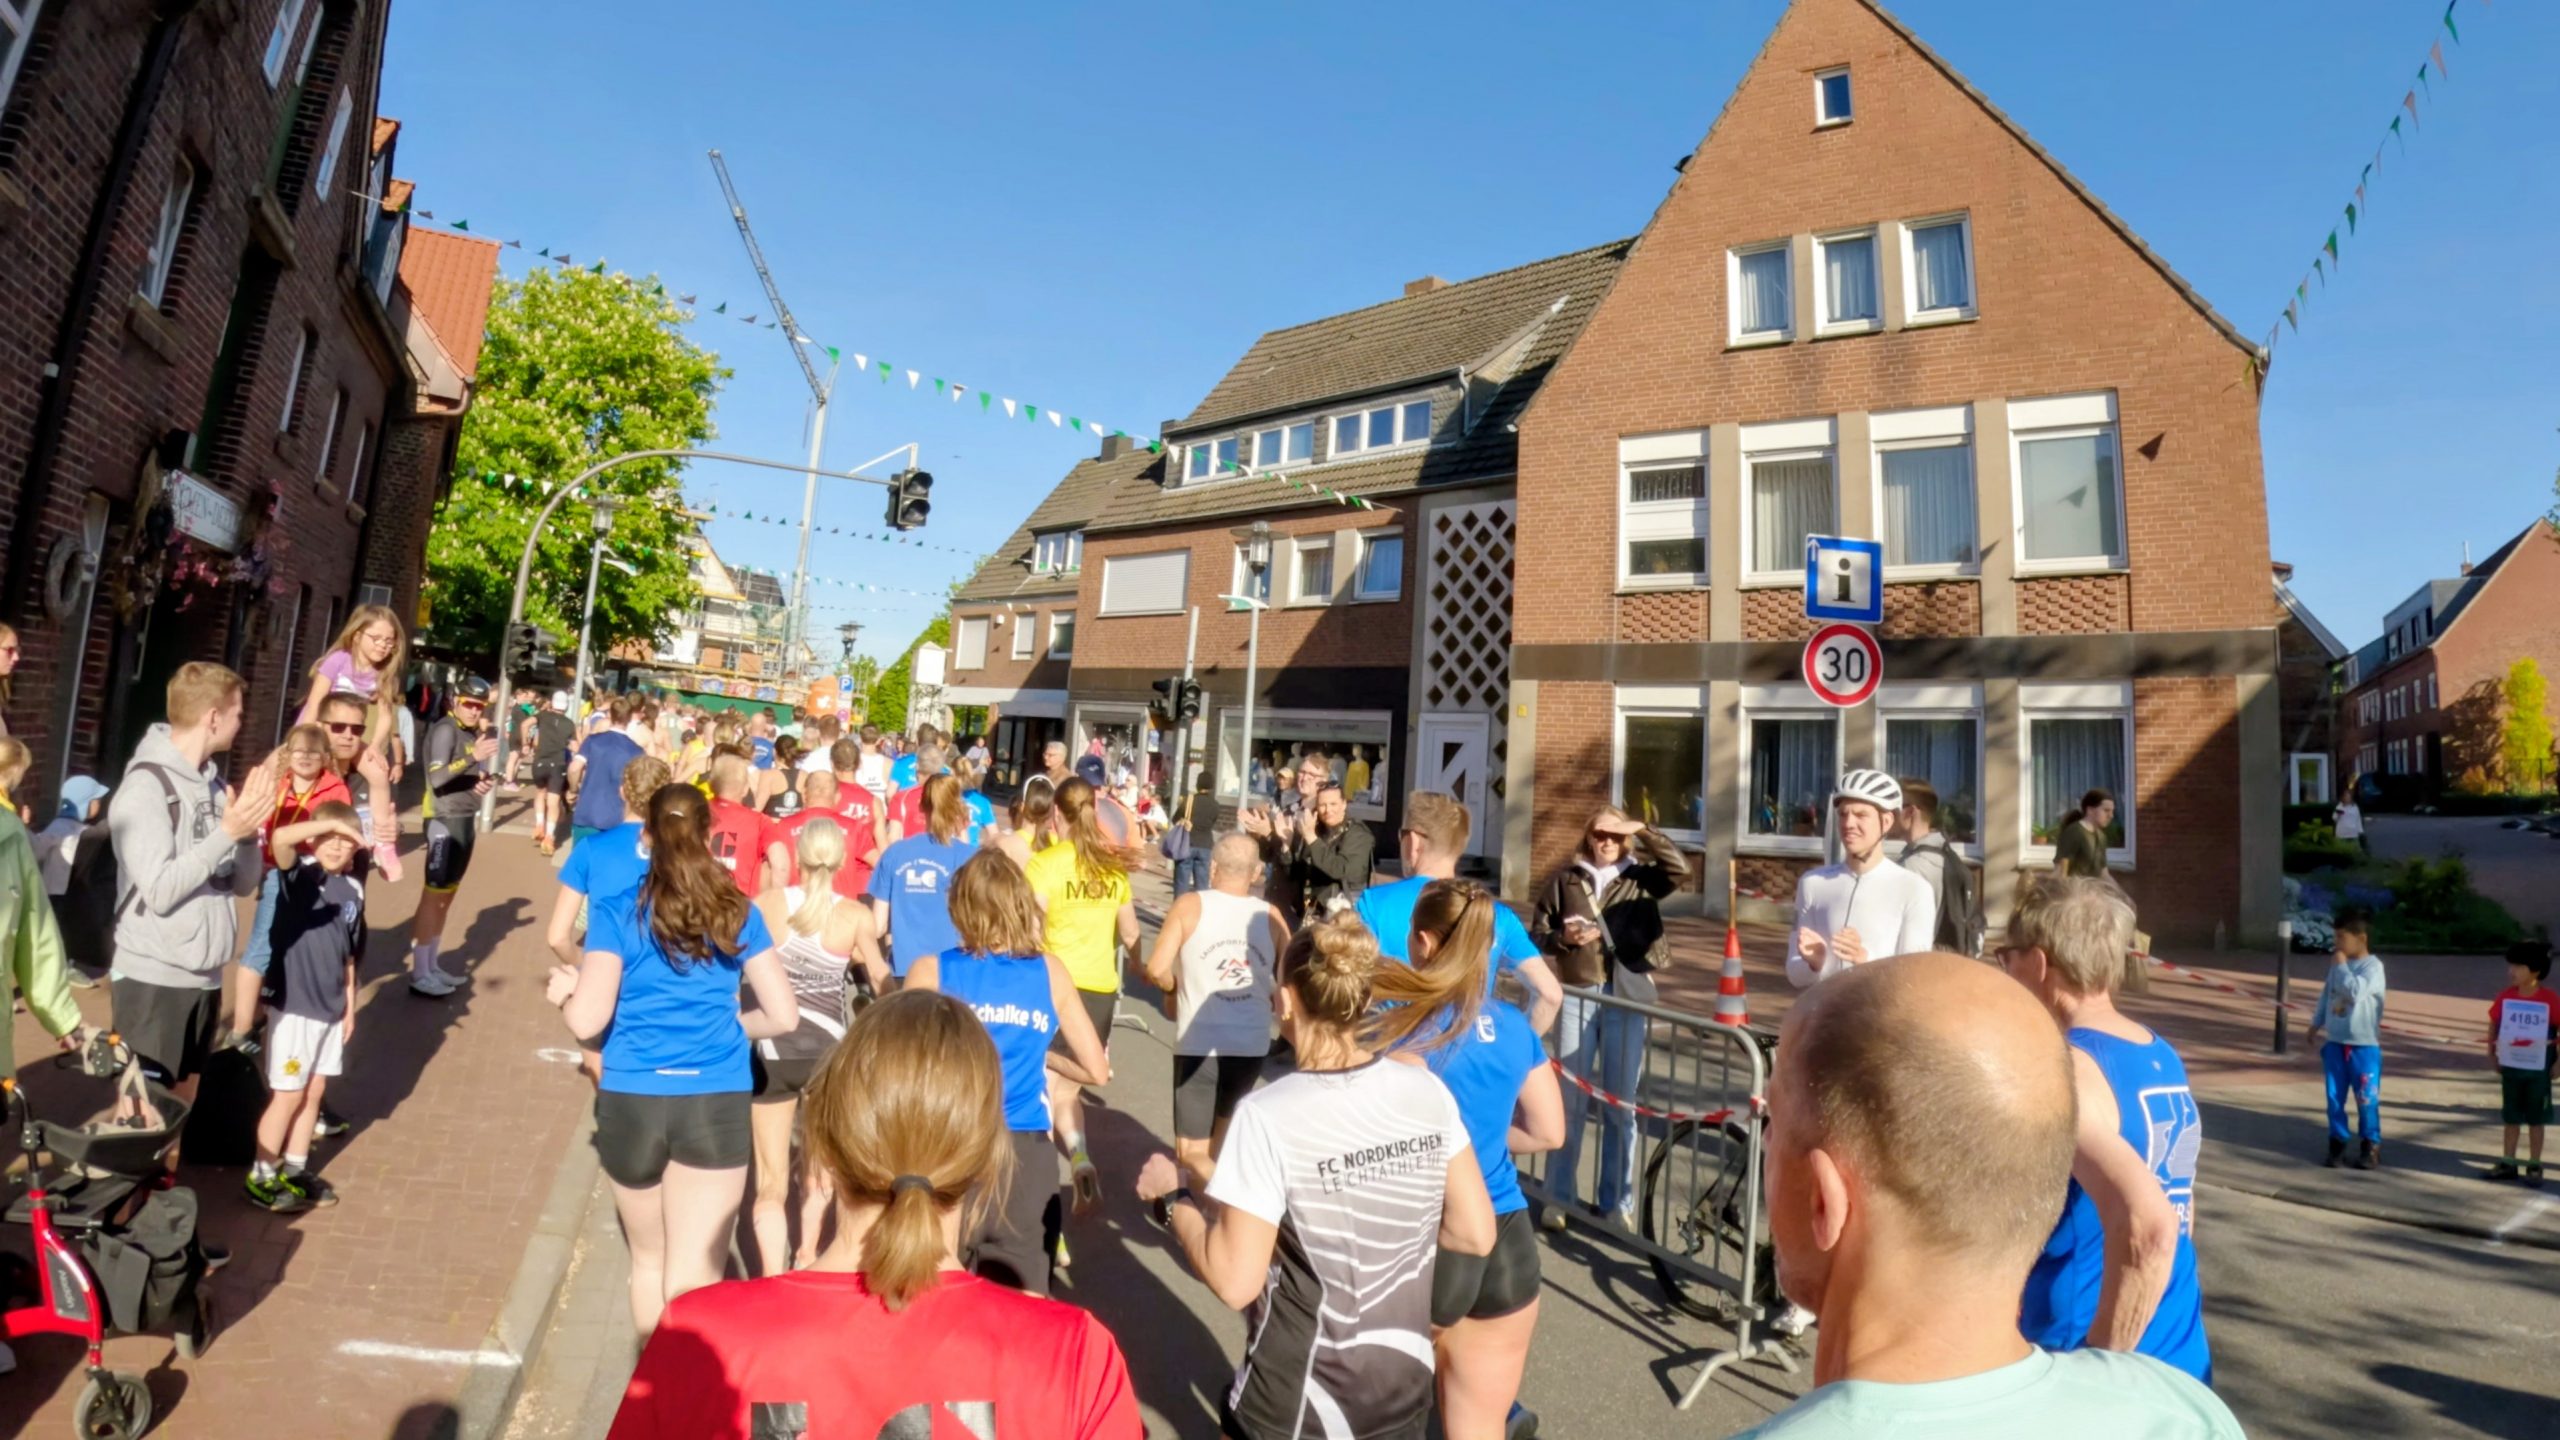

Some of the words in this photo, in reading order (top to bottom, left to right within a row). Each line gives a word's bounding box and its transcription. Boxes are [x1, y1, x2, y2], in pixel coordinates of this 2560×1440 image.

[1822, 646, 1865, 683] 30
[1066, 880, 1118, 900] MOM
[1032, 1009, 1050, 1033] 96
[2509, 1012, 2540, 1026] 4183
[1317, 1157, 1340, 1178] FC
[1343, 1131, 1443, 1170] NORDKIRCHEN
